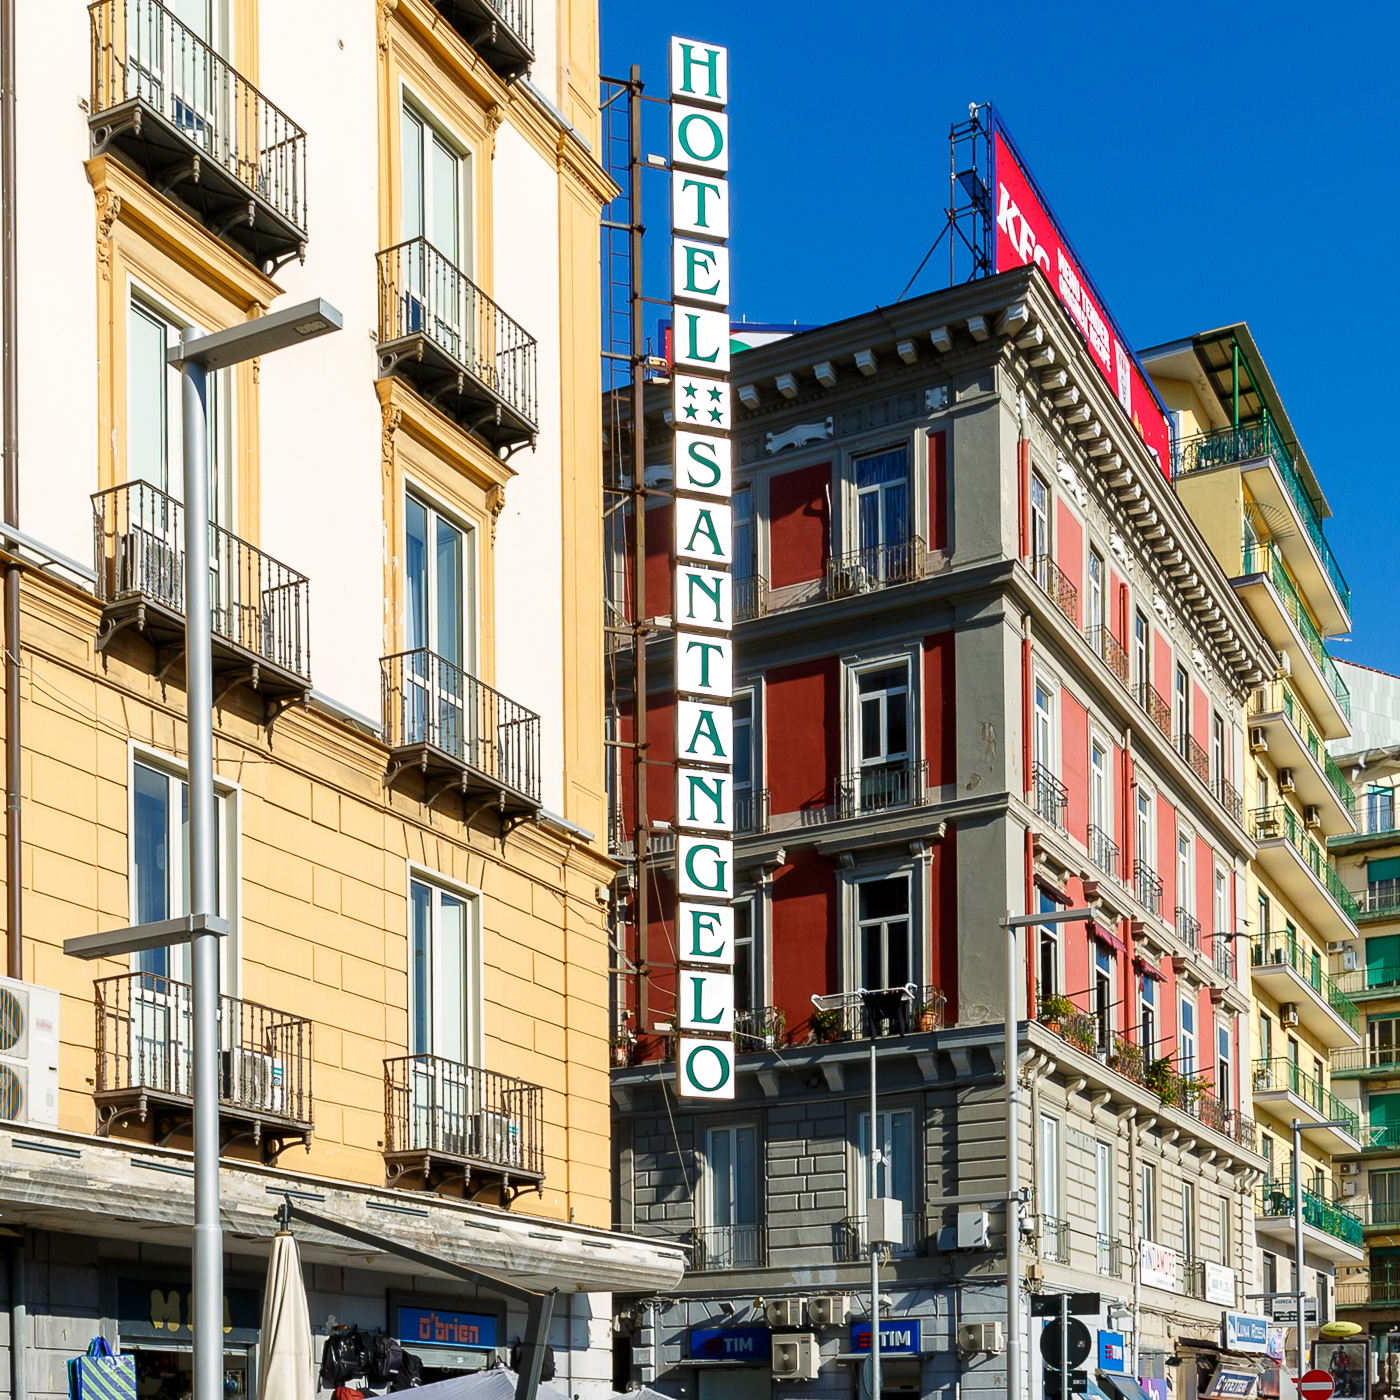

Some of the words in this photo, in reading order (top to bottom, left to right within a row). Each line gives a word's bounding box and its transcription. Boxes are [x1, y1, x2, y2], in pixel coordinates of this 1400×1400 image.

[678, 44, 724, 364] HOTEL
[996, 181, 1050, 272] KFC
[1057, 247, 1080, 302] MENU
[1080, 286, 1110, 355] TENDER
[686, 440, 731, 1092] SANTANGELO
[724, 1337, 753, 1352] TIM
[879, 1330, 911, 1347] TIM
